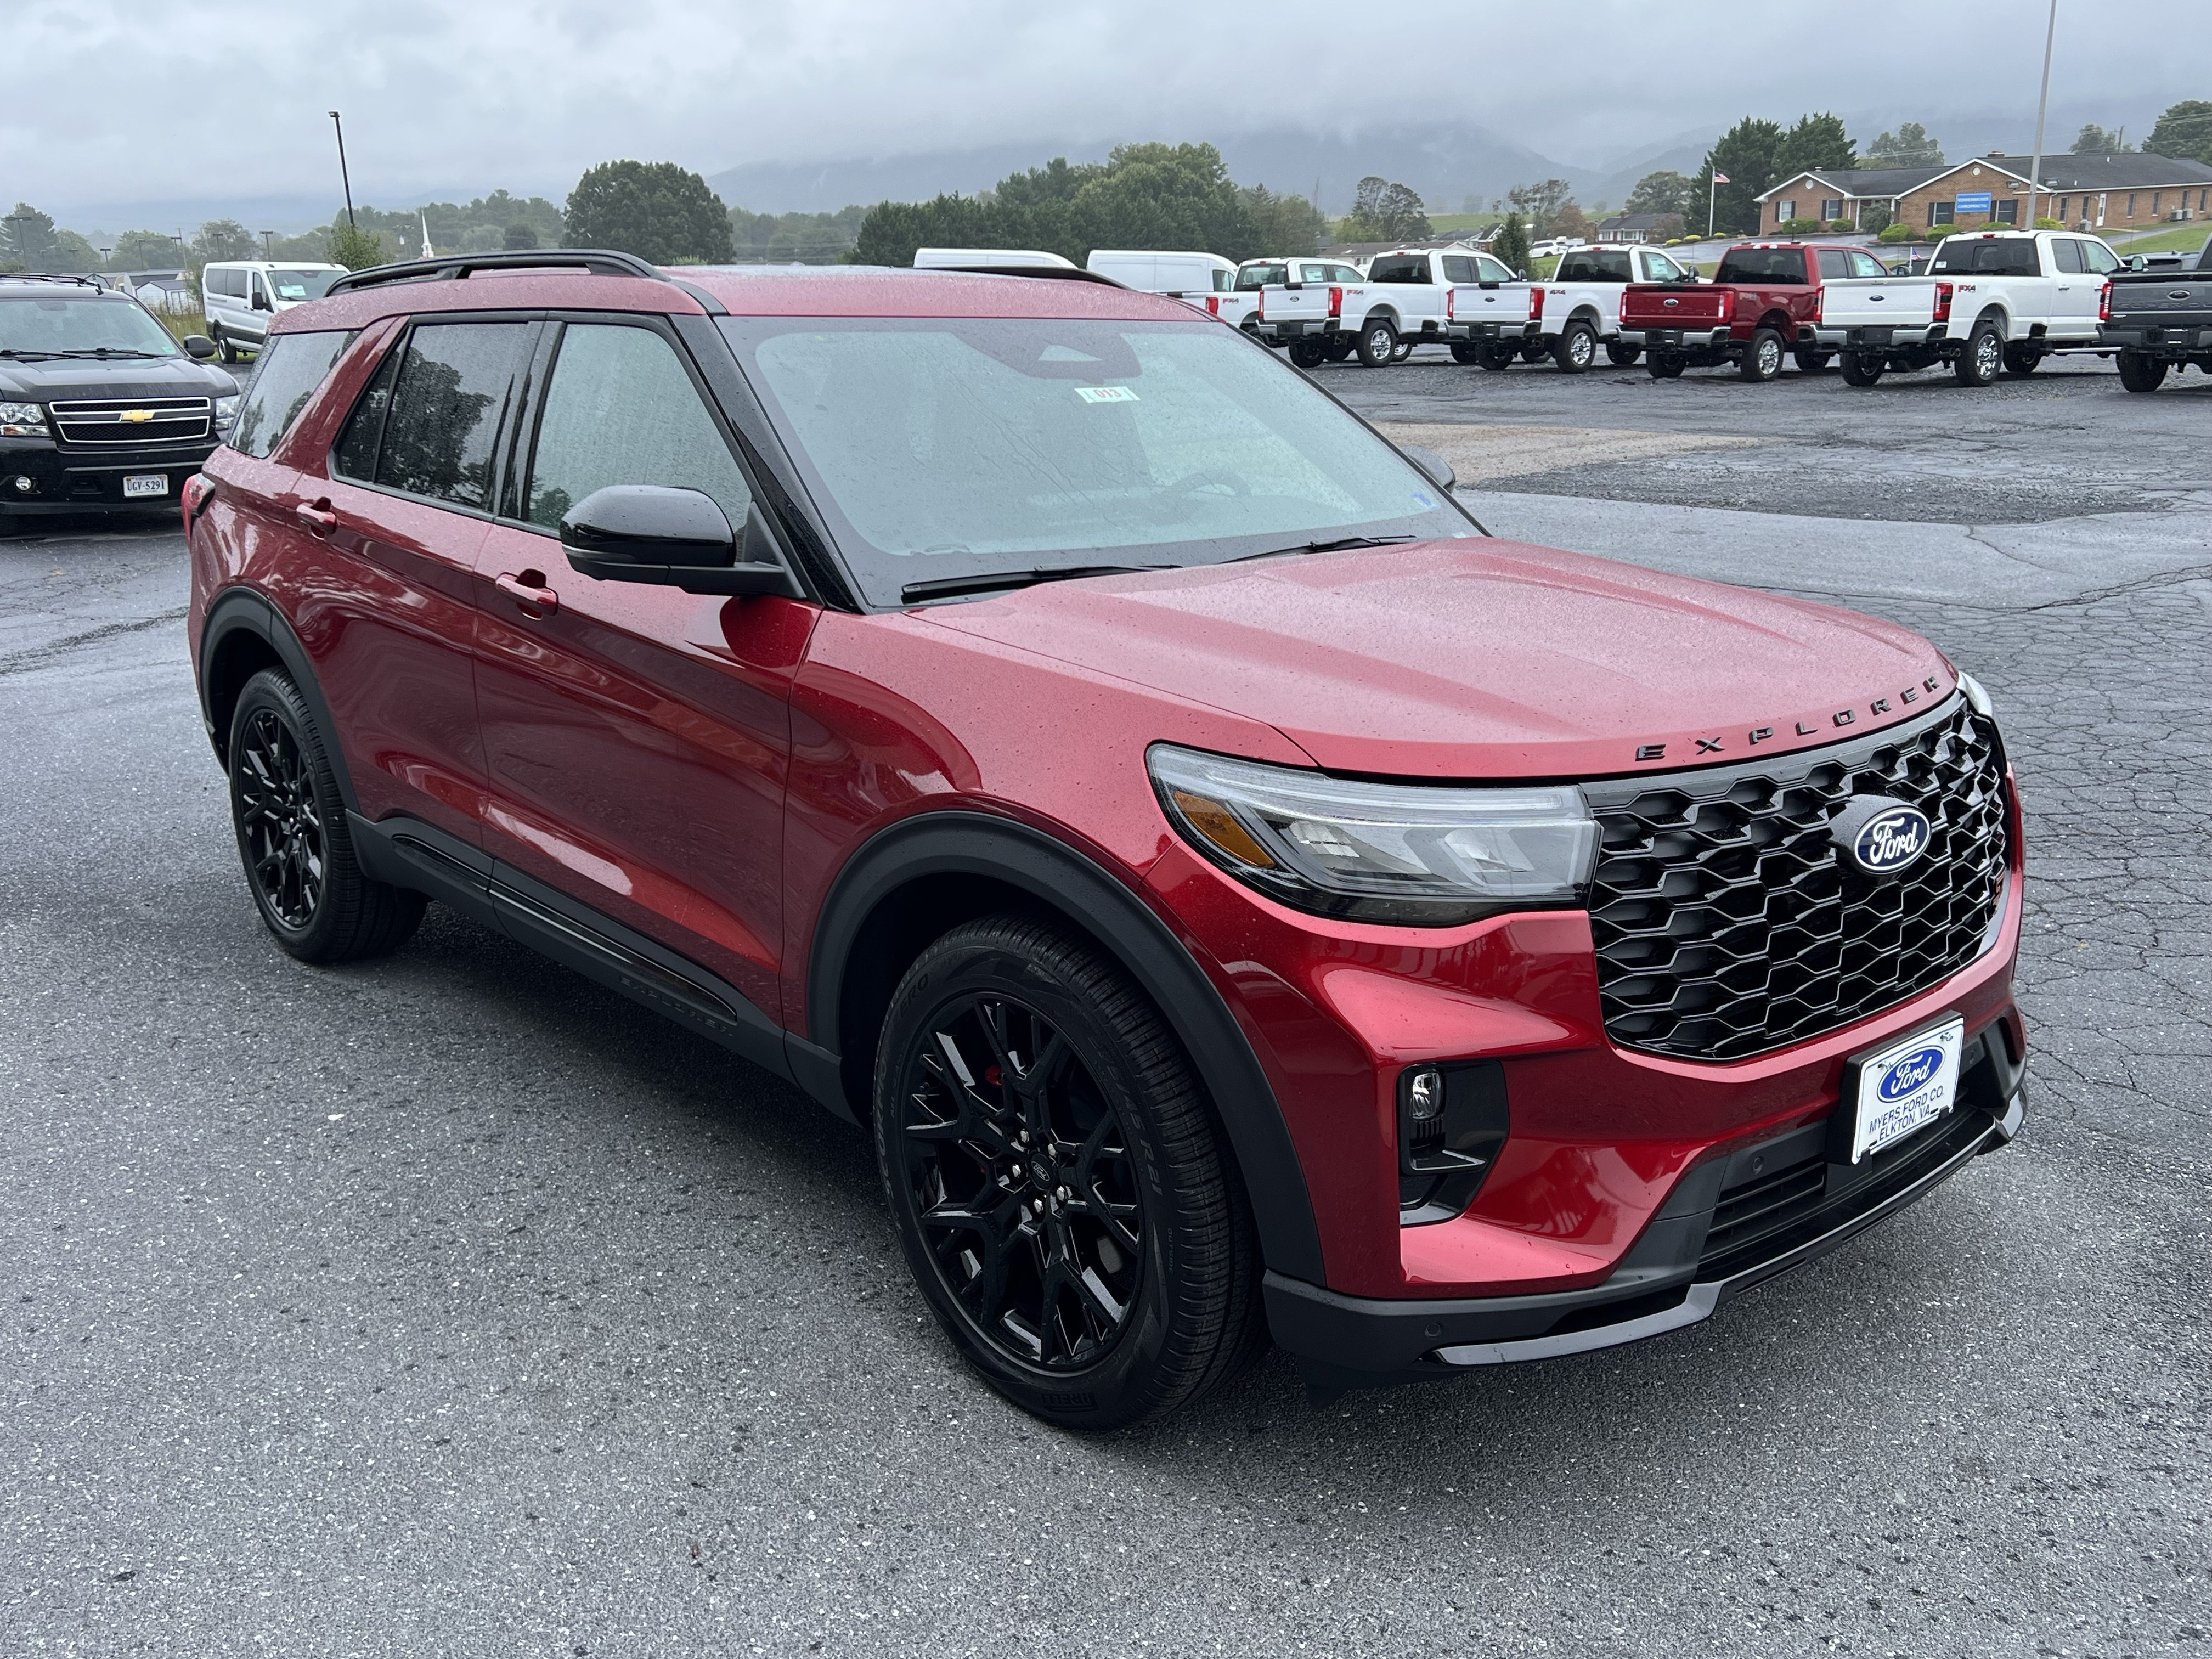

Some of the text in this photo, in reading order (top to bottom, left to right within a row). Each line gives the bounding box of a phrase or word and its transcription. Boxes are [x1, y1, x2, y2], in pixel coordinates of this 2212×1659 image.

[1093, 388, 1122, 398] 013
[127, 479, 165, 492] UGV-5291
[1635, 676, 1940, 760] EXPLORER
[1870, 817, 1918, 864] Ford
[1891, 1054, 1932, 1095] Ford
[1869, 1085, 1944, 1134] MYERS FORD CO.
